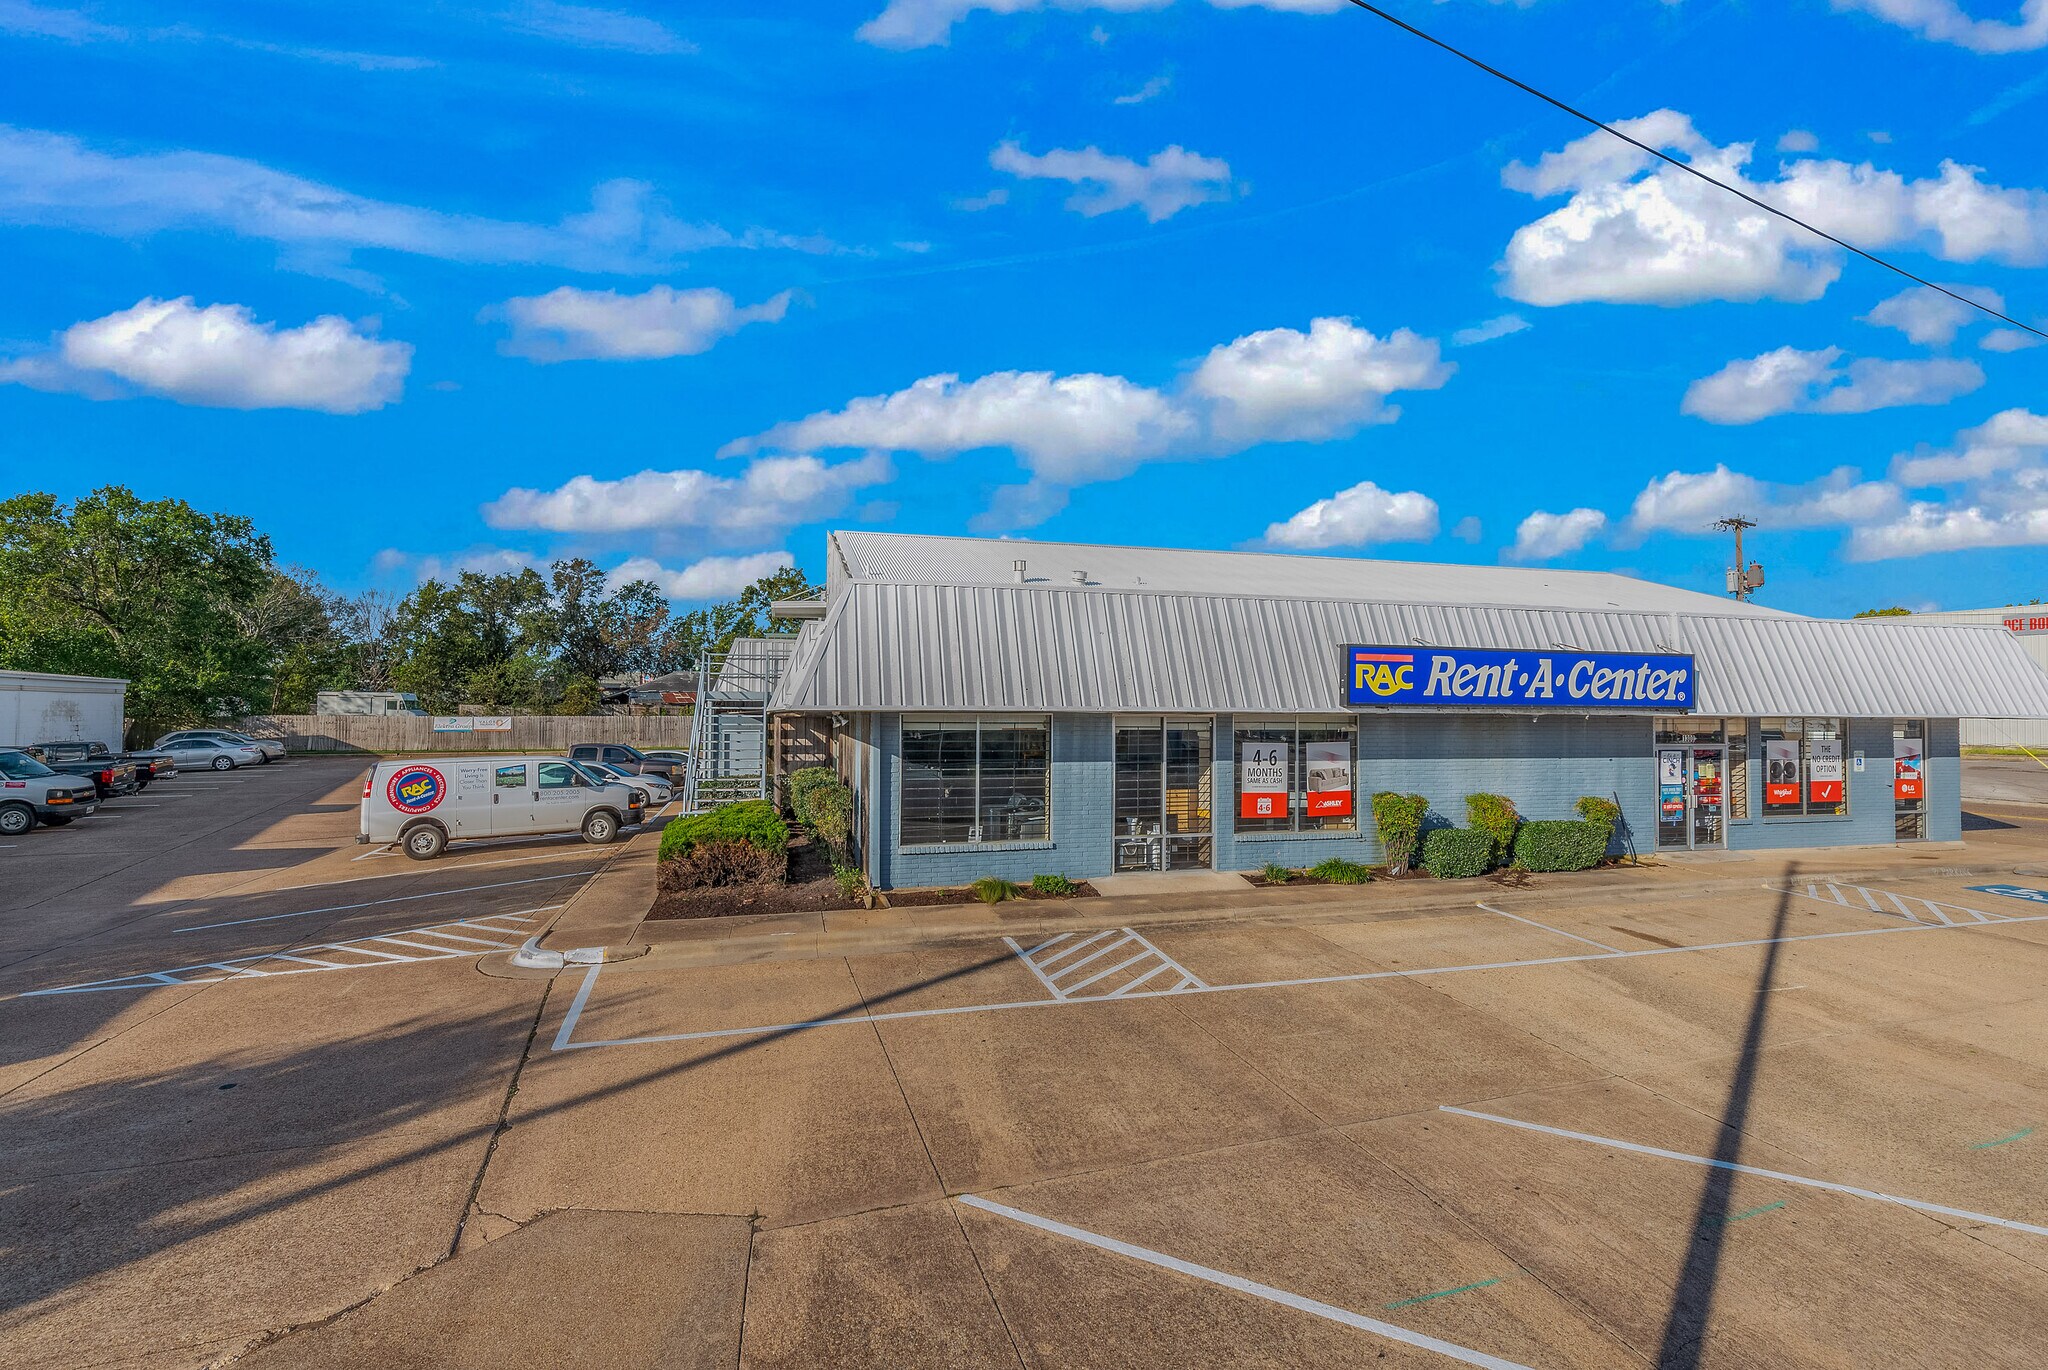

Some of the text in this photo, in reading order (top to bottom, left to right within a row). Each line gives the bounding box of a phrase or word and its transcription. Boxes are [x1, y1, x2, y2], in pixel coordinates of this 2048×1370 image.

[2029, 617, 2048, 630] BO
[1355, 663, 1414, 696] RAC
[1821, 745, 1831, 753] THE
[1252, 749, 1278, 766] 4-6
[1812, 755, 1840, 763] NO CREDIT
[401, 766, 433, 775] APPLIANCES
[1247, 767, 1283, 777] MONTHS
[1816, 765, 1837, 773] OPTION
[401, 779, 432, 798] RAC
